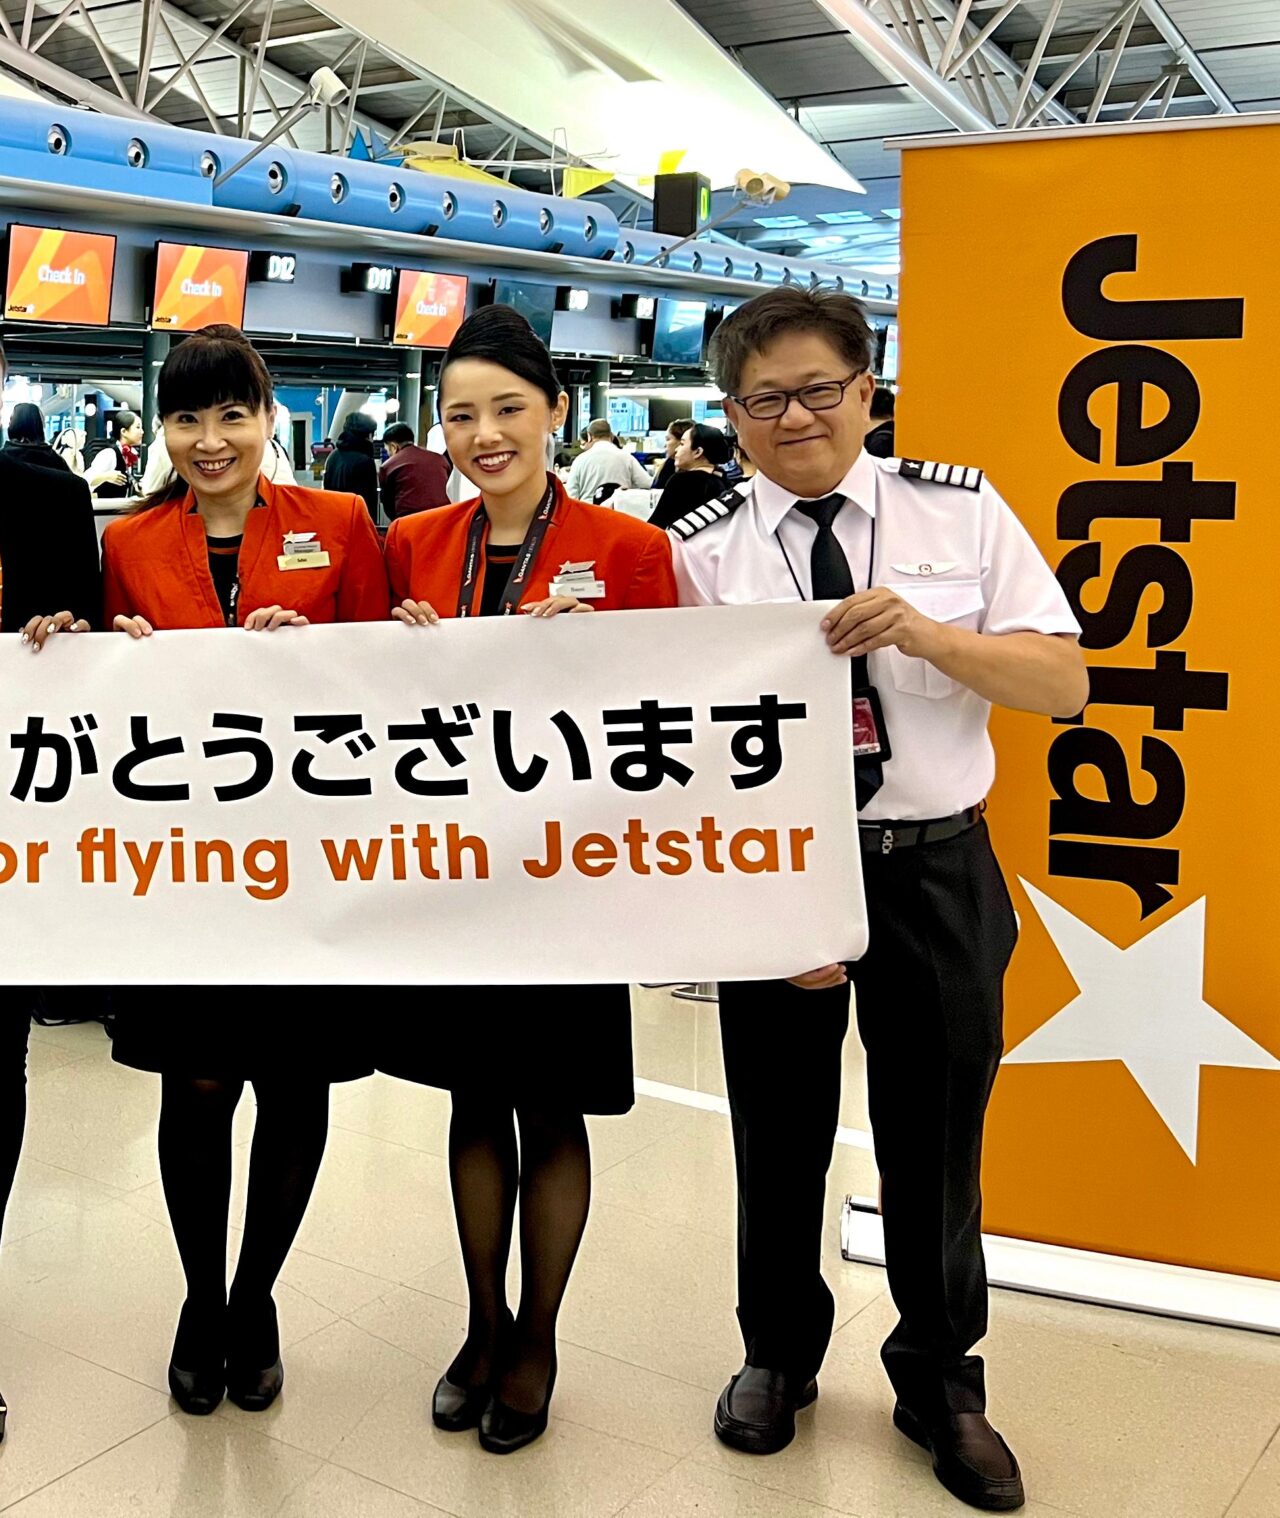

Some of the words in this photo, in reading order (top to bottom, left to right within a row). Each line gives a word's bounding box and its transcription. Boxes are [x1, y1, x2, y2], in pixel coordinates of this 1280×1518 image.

[38, 264, 72, 285] Check
[268, 255, 296, 280] D12
[367, 266, 393, 290] D11
[181, 278, 210, 297] Check
[1048, 234, 1244, 921] Jetstar
[76, 827, 289, 900] flying
[320, 823, 489, 882] with
[522, 816, 814, 879] Jetstar
